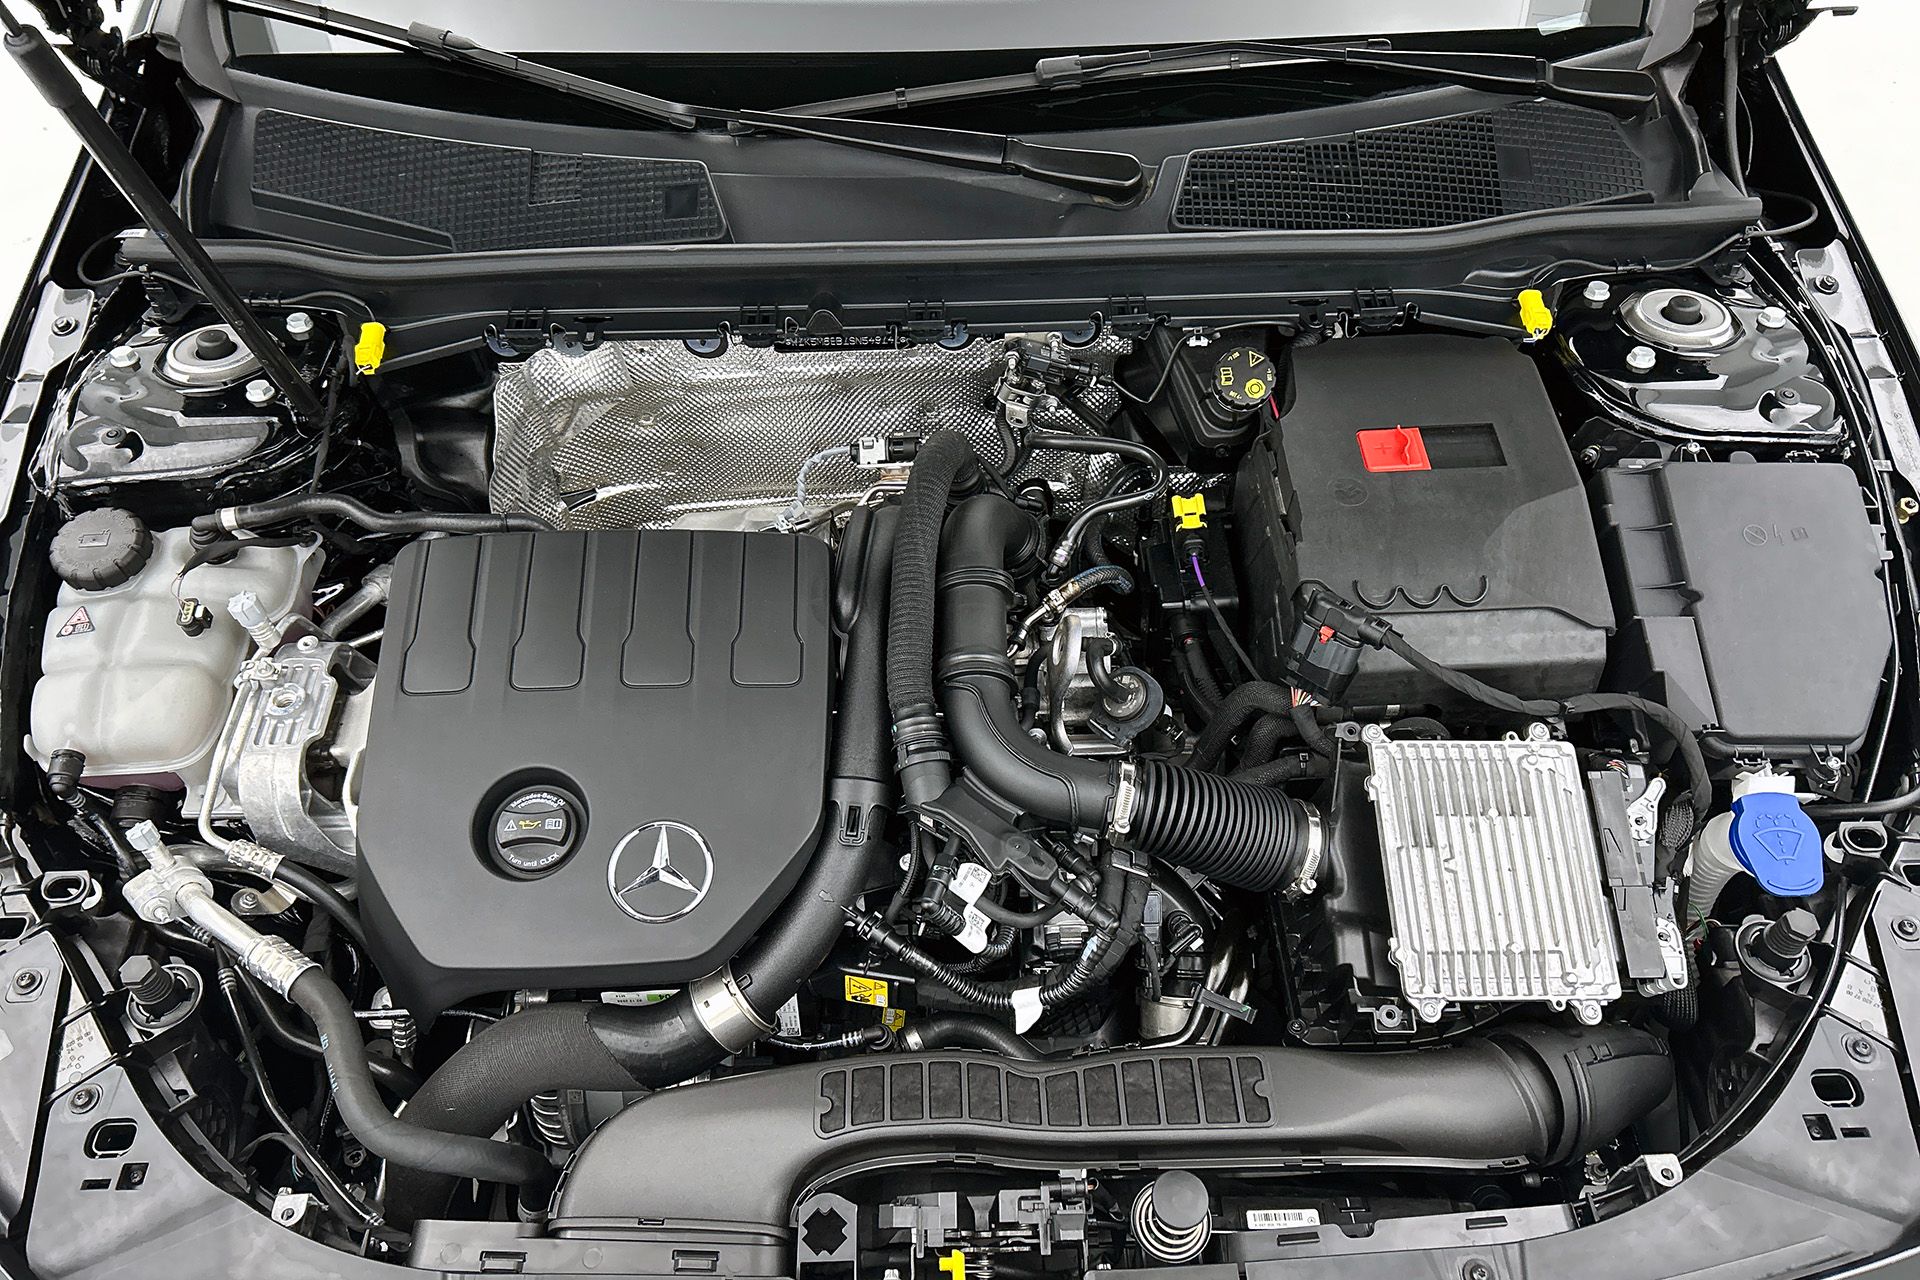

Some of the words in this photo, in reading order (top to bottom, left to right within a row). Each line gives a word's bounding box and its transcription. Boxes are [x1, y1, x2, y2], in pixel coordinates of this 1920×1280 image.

[511, 792, 558, 808] Mercedes-Benz
[517, 798, 558, 808] recommended
[508, 853, 521, 864] Turn
[539, 852, 559, 865] CLICK
